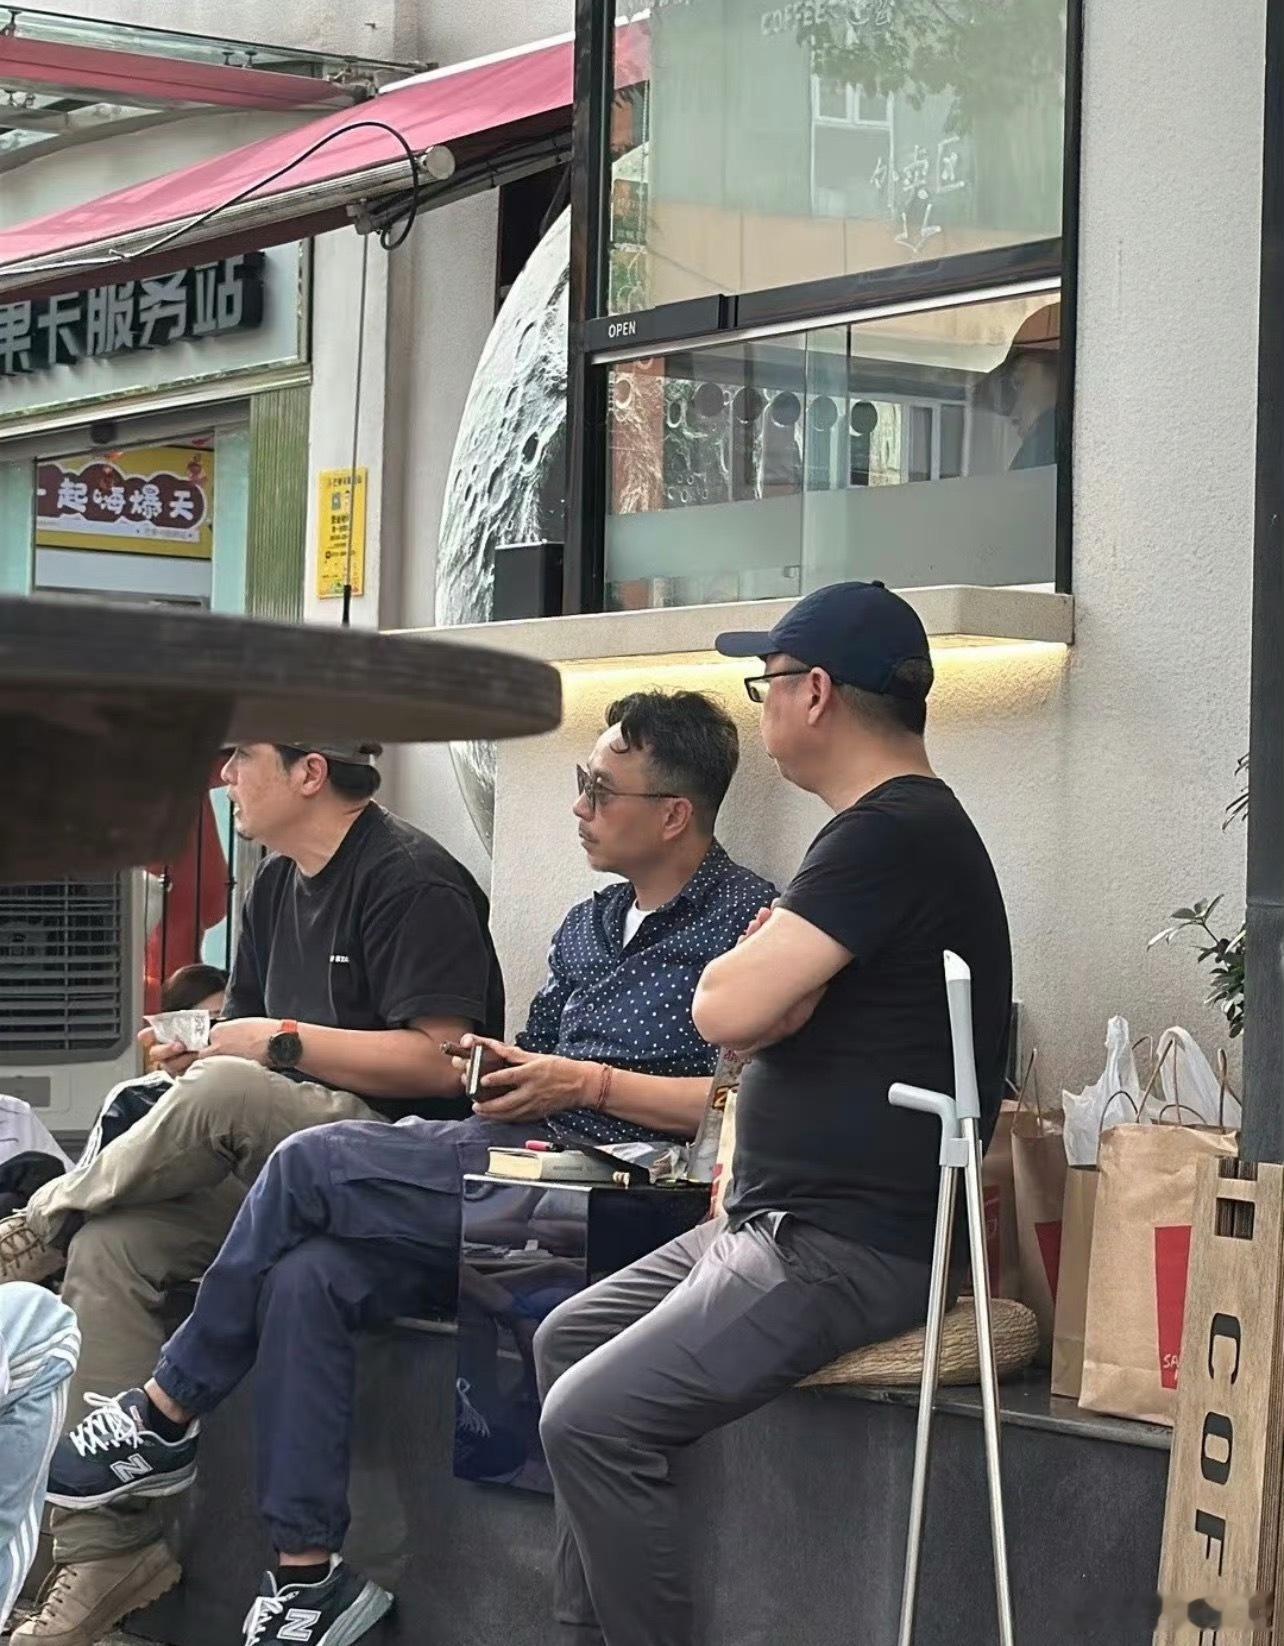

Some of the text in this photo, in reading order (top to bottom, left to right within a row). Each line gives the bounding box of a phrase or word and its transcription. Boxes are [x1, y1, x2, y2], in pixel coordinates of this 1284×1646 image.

[0, 254, 245, 374] 果卡服务站
[608, 319, 636, 338] OPEN
[110, 1453, 153, 1483] N
[277, 1608, 322, 1642] N
